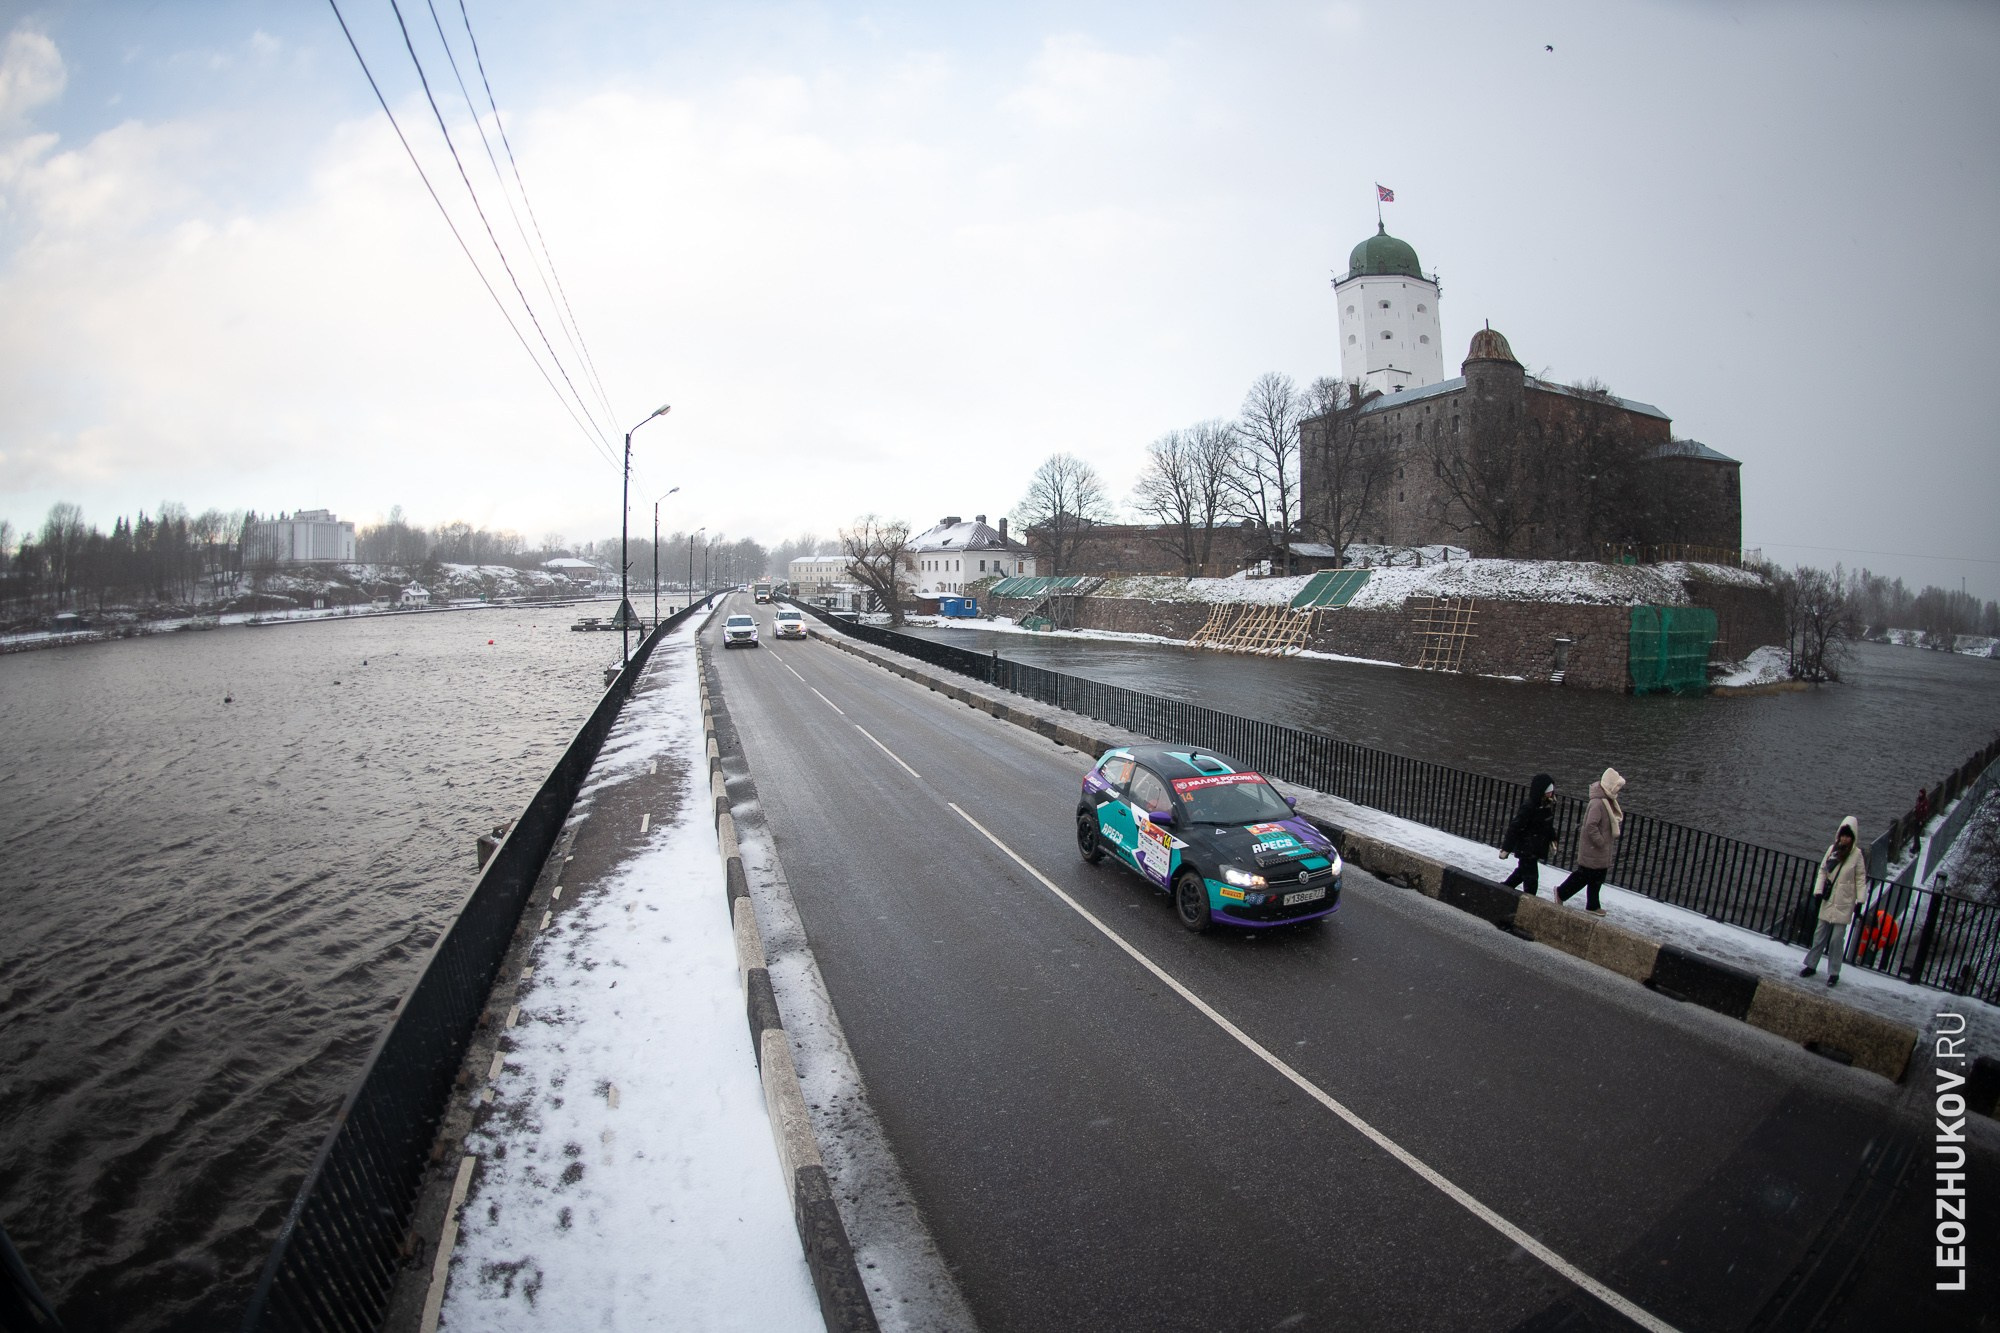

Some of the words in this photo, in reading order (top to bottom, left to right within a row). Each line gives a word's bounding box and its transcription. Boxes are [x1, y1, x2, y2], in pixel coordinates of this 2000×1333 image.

[1188, 777, 1219, 787] РАЛЛИ
[1220, 775, 1253, 783] РОССИИ
[1180, 792, 1194, 803] 14
[1101, 823, 1123, 845] APECS
[1162, 834, 1172, 850] 14
[1252, 838, 1293, 854] APECS
